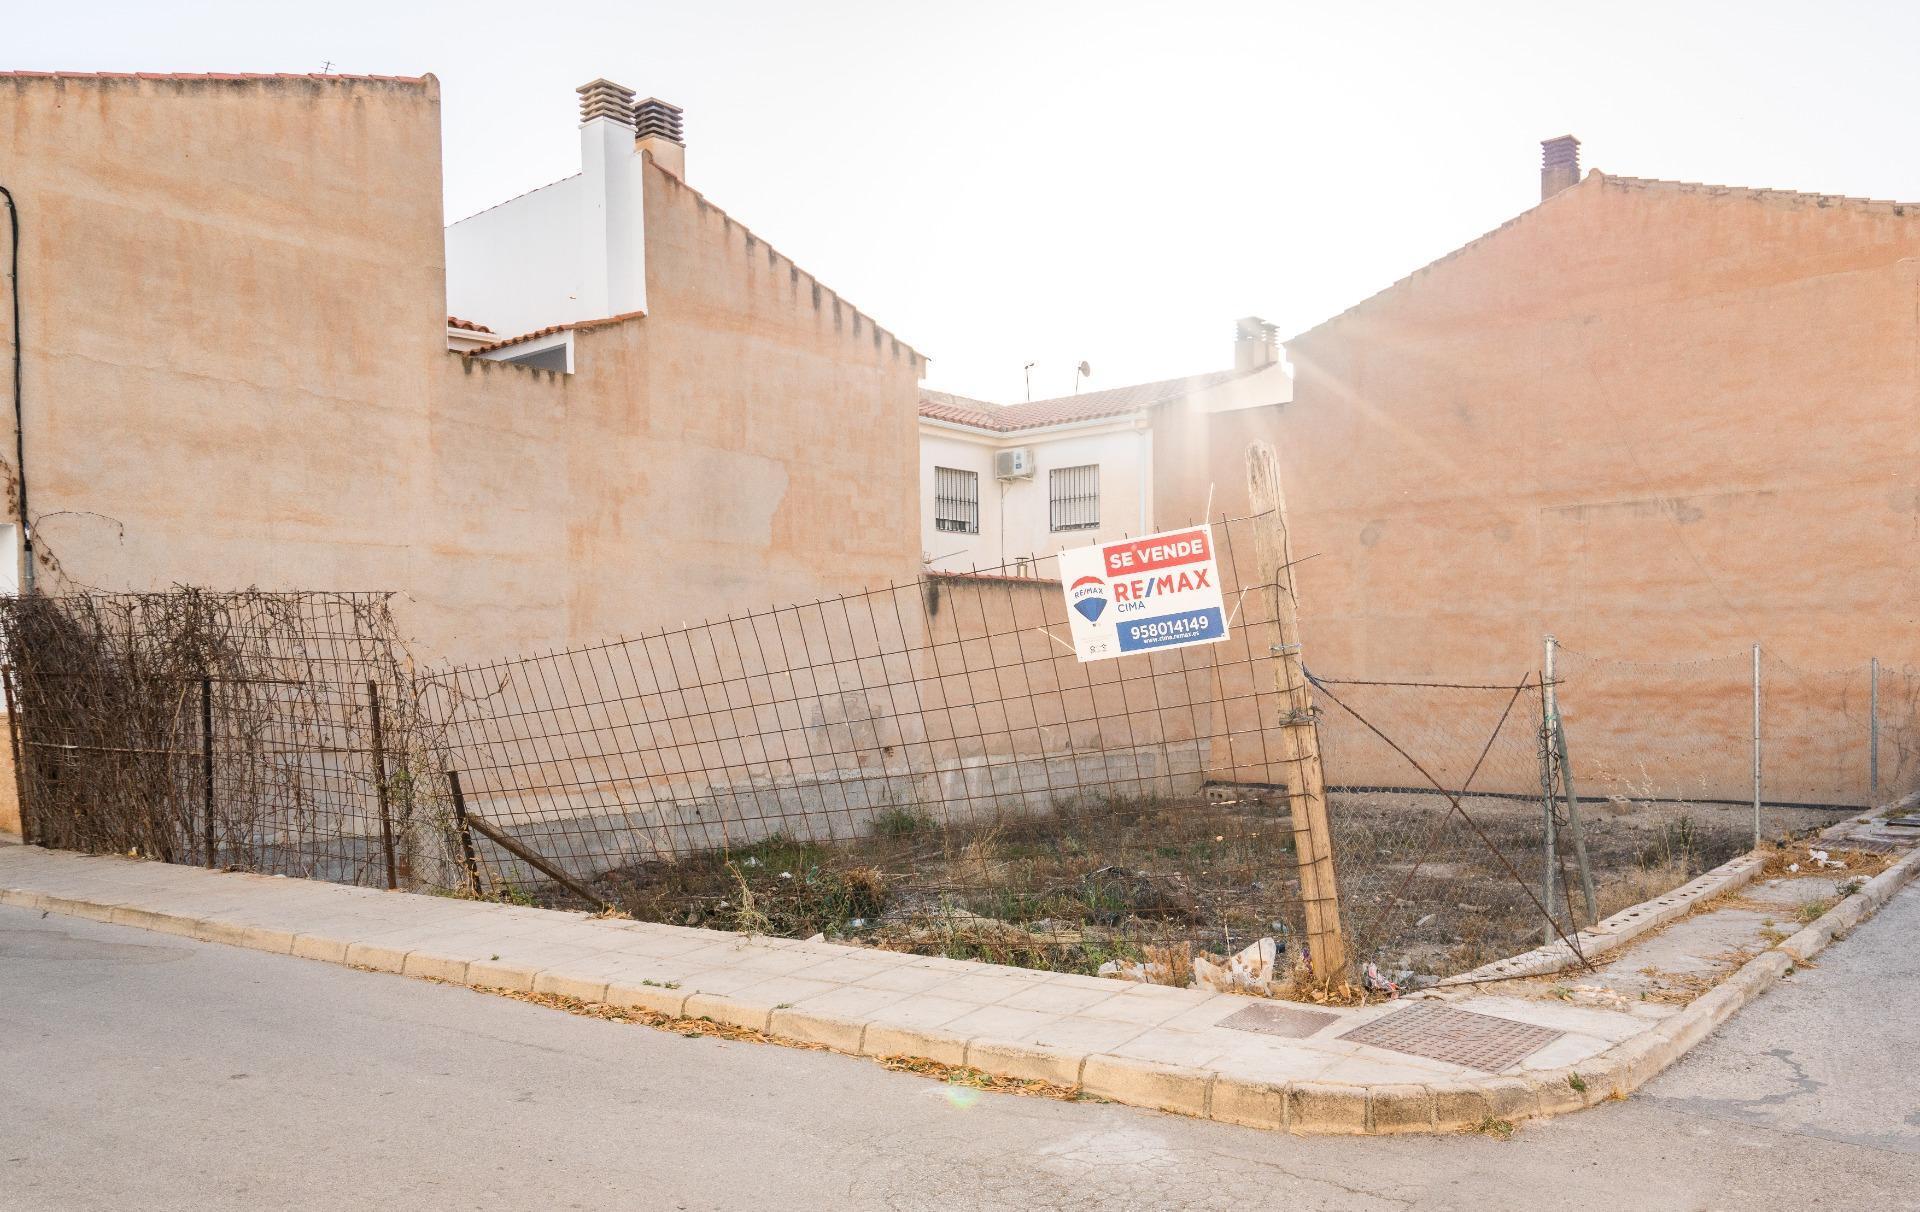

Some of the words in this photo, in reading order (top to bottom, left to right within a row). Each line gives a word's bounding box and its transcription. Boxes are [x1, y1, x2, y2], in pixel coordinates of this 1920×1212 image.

[1110, 553, 1134, 569] SE
[1137, 539, 1203, 564] VENDE
[1074, 587, 1104, 599] RE/MAX
[1114, 568, 1211, 603] RE/MAX
[1117, 601, 1146, 613] CIMA
[1131, 615, 1209, 640] 958014149
